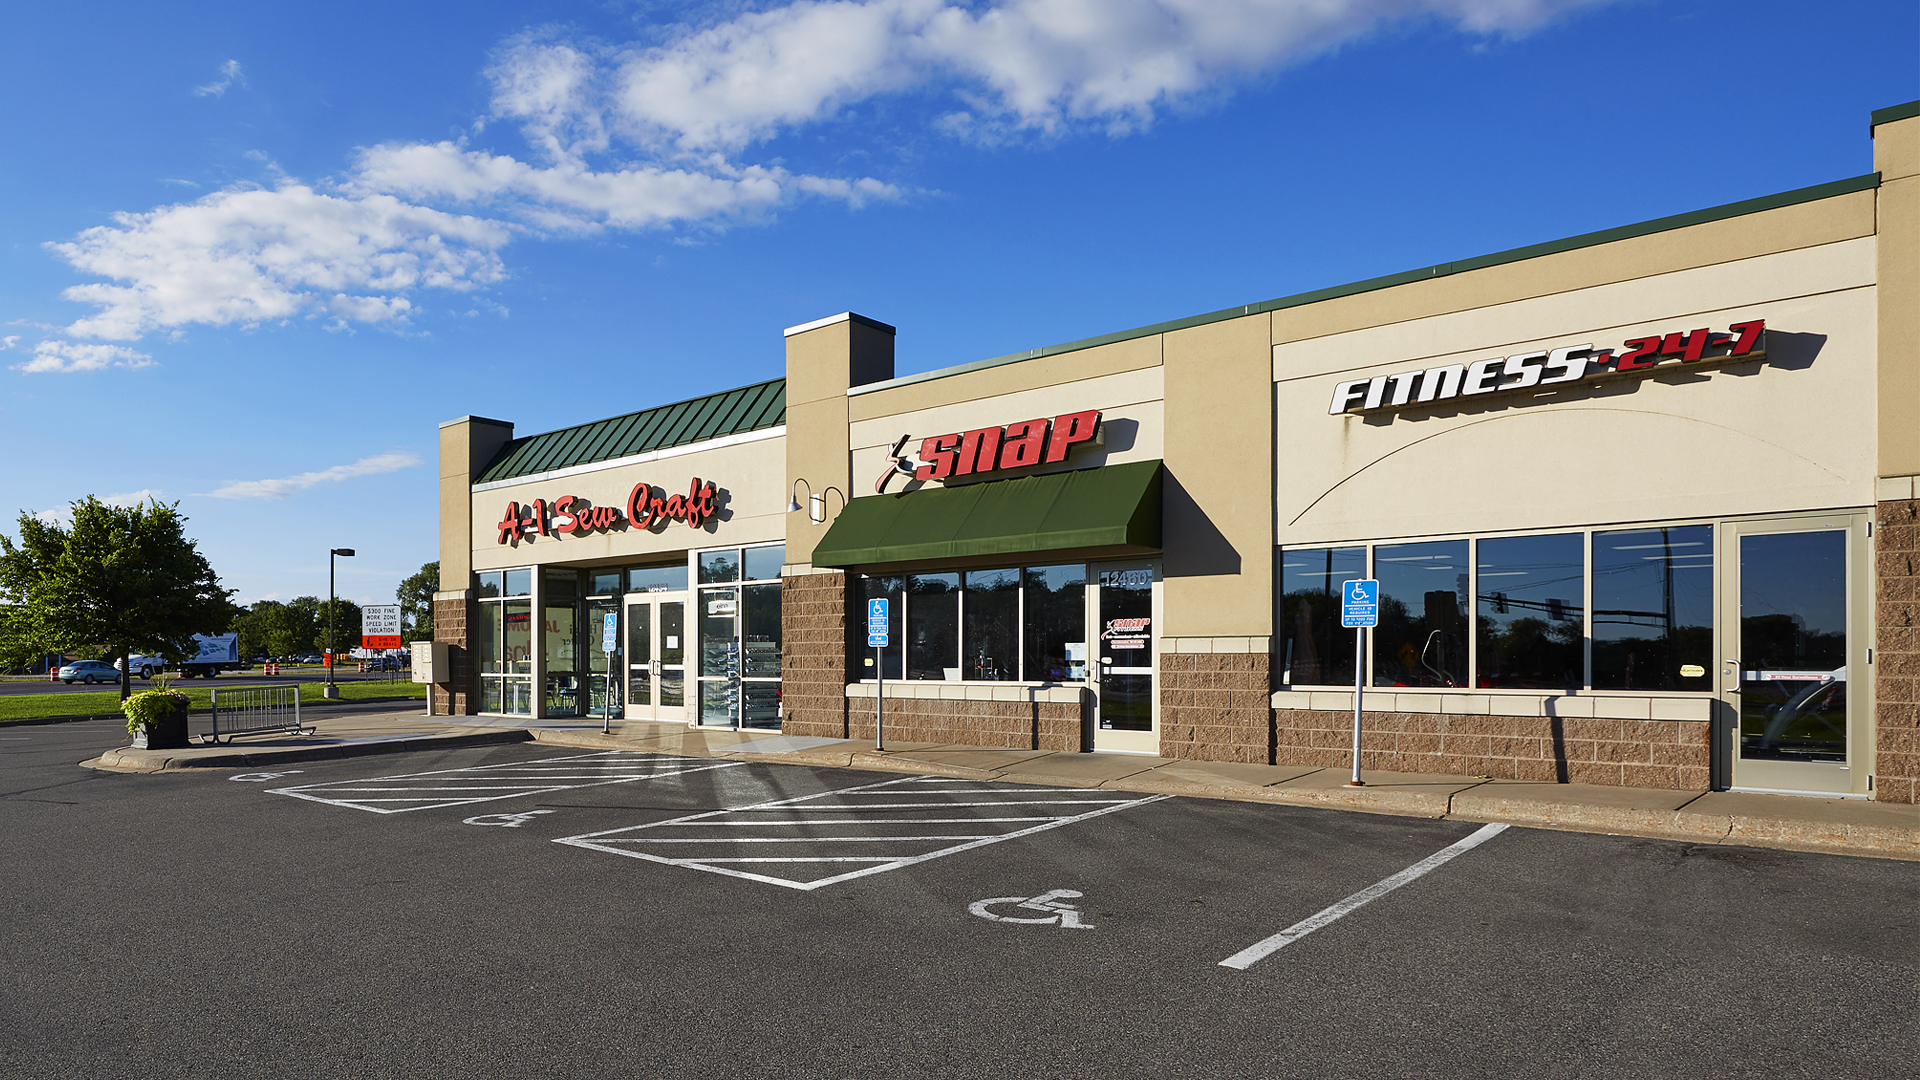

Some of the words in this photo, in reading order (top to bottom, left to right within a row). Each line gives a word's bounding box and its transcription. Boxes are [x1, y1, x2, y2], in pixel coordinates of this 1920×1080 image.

[1328, 343, 1594, 415] FITNESS
[498, 498, 547, 544] A-1
[555, 495, 617, 533] Sew
[627, 477, 714, 529] Craft
[1105, 571, 1148, 586] 12460
